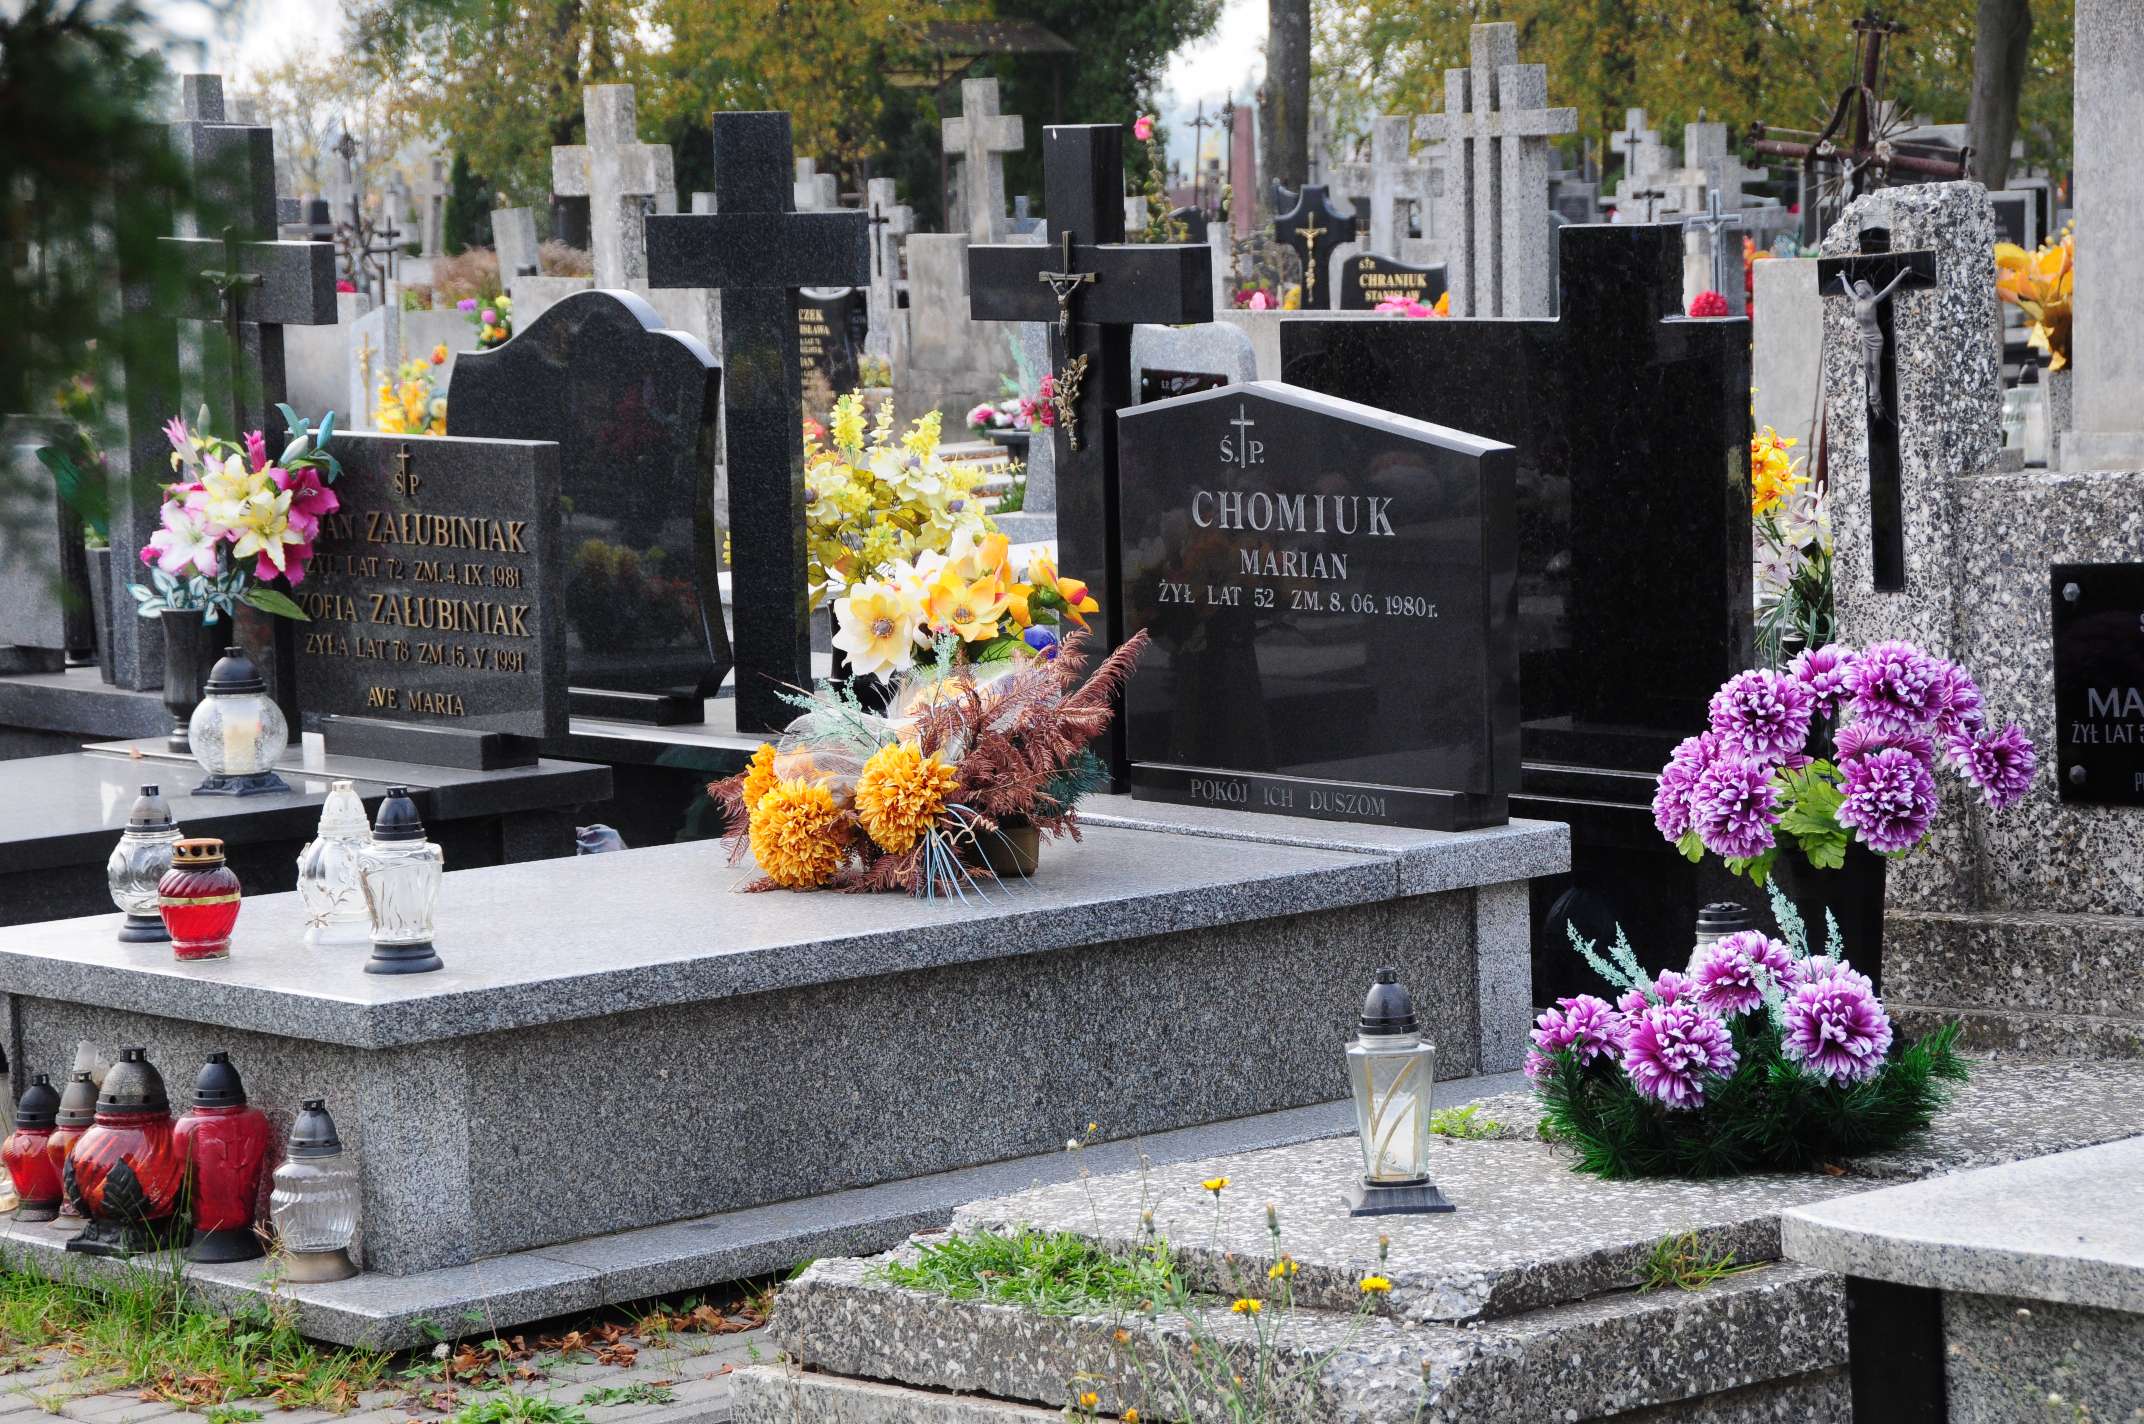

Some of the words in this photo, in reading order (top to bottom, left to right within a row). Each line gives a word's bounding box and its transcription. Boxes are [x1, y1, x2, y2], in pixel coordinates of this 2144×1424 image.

[1359, 272, 1427, 289] CHRANIUK
[1191, 490, 1396, 537] CHOMIUK
[367, 510, 528, 554] ZAŁUBINIAK
[347, 555, 379, 578] LAT
[387, 558, 404, 580] 72
[1239, 547, 1348, 580] MARIAN
[1158, 578, 1195, 604] ŻYŁ
[1207, 585, 1243, 606] LAT
[1253, 588, 1275, 608] 52
[1291, 591, 1324, 611] ZM.
[1384, 595, 1439, 618] 1980r.
[298, 592, 359, 623] ZOFIA
[370, 593, 531, 638] ZAŁUBINIAK
[355, 637, 386, 660] LAT
[393, 640, 410, 662] 78
[367, 686, 399, 710] AVE
[407, 690, 466, 716] MARIA
[2071, 721, 2099, 745] ŻYŁ
[2105, 723, 2134, 745] LAT
[1190, 778, 1249, 804] POKÓJ
[1263, 785, 1294, 808] ICH
[1309, 789, 1387, 817] DUSZOM
